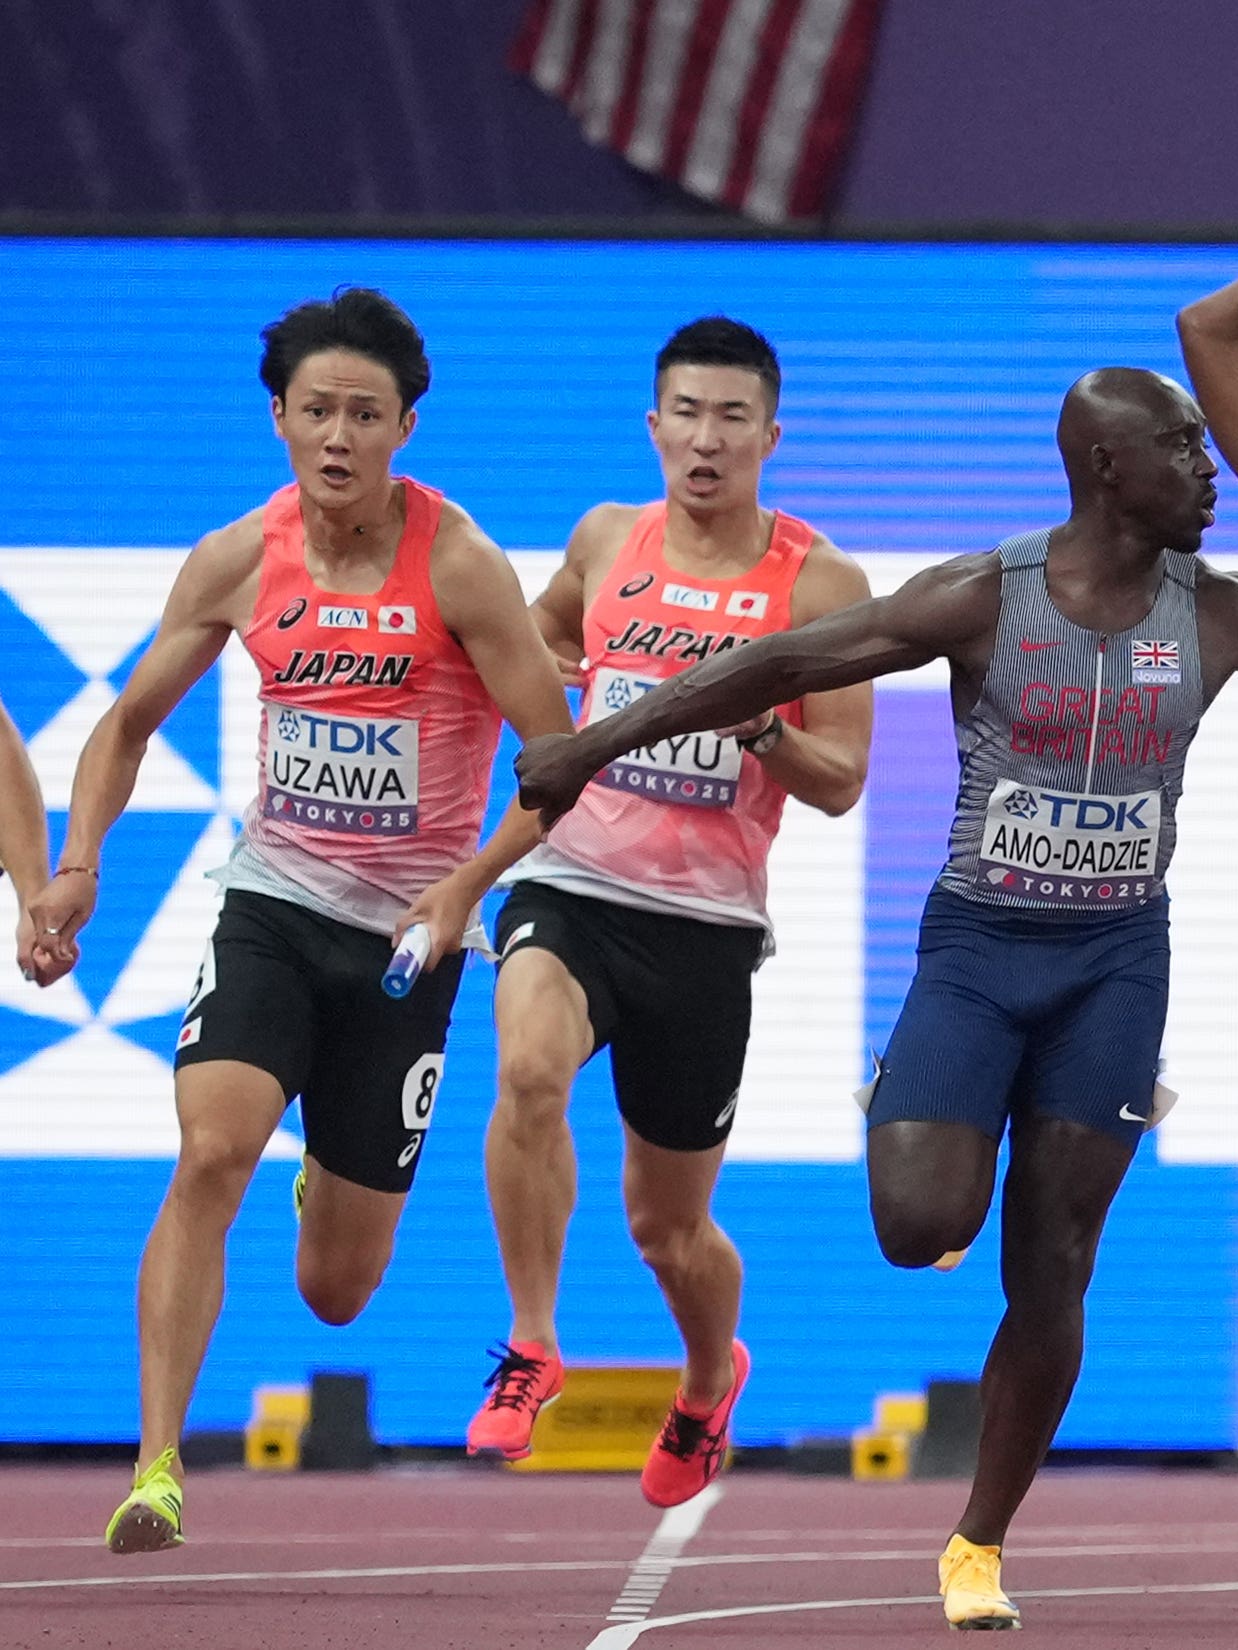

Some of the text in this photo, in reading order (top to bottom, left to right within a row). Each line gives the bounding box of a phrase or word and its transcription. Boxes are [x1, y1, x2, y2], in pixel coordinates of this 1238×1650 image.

[322, 609, 364, 627] ACN
[274, 650, 414, 688] JAPAN
[1020, 681, 1167, 725] GREAT
[301, 714, 403, 757] TDK
[1011, 722, 1174, 765] BRITAIN
[273, 751, 406, 801] UZAWA
[1040, 793, 1150, 833] TDK
[990, 824, 1151, 873] AMO-DADZIE
[415, 1067, 437, 1119] 8
